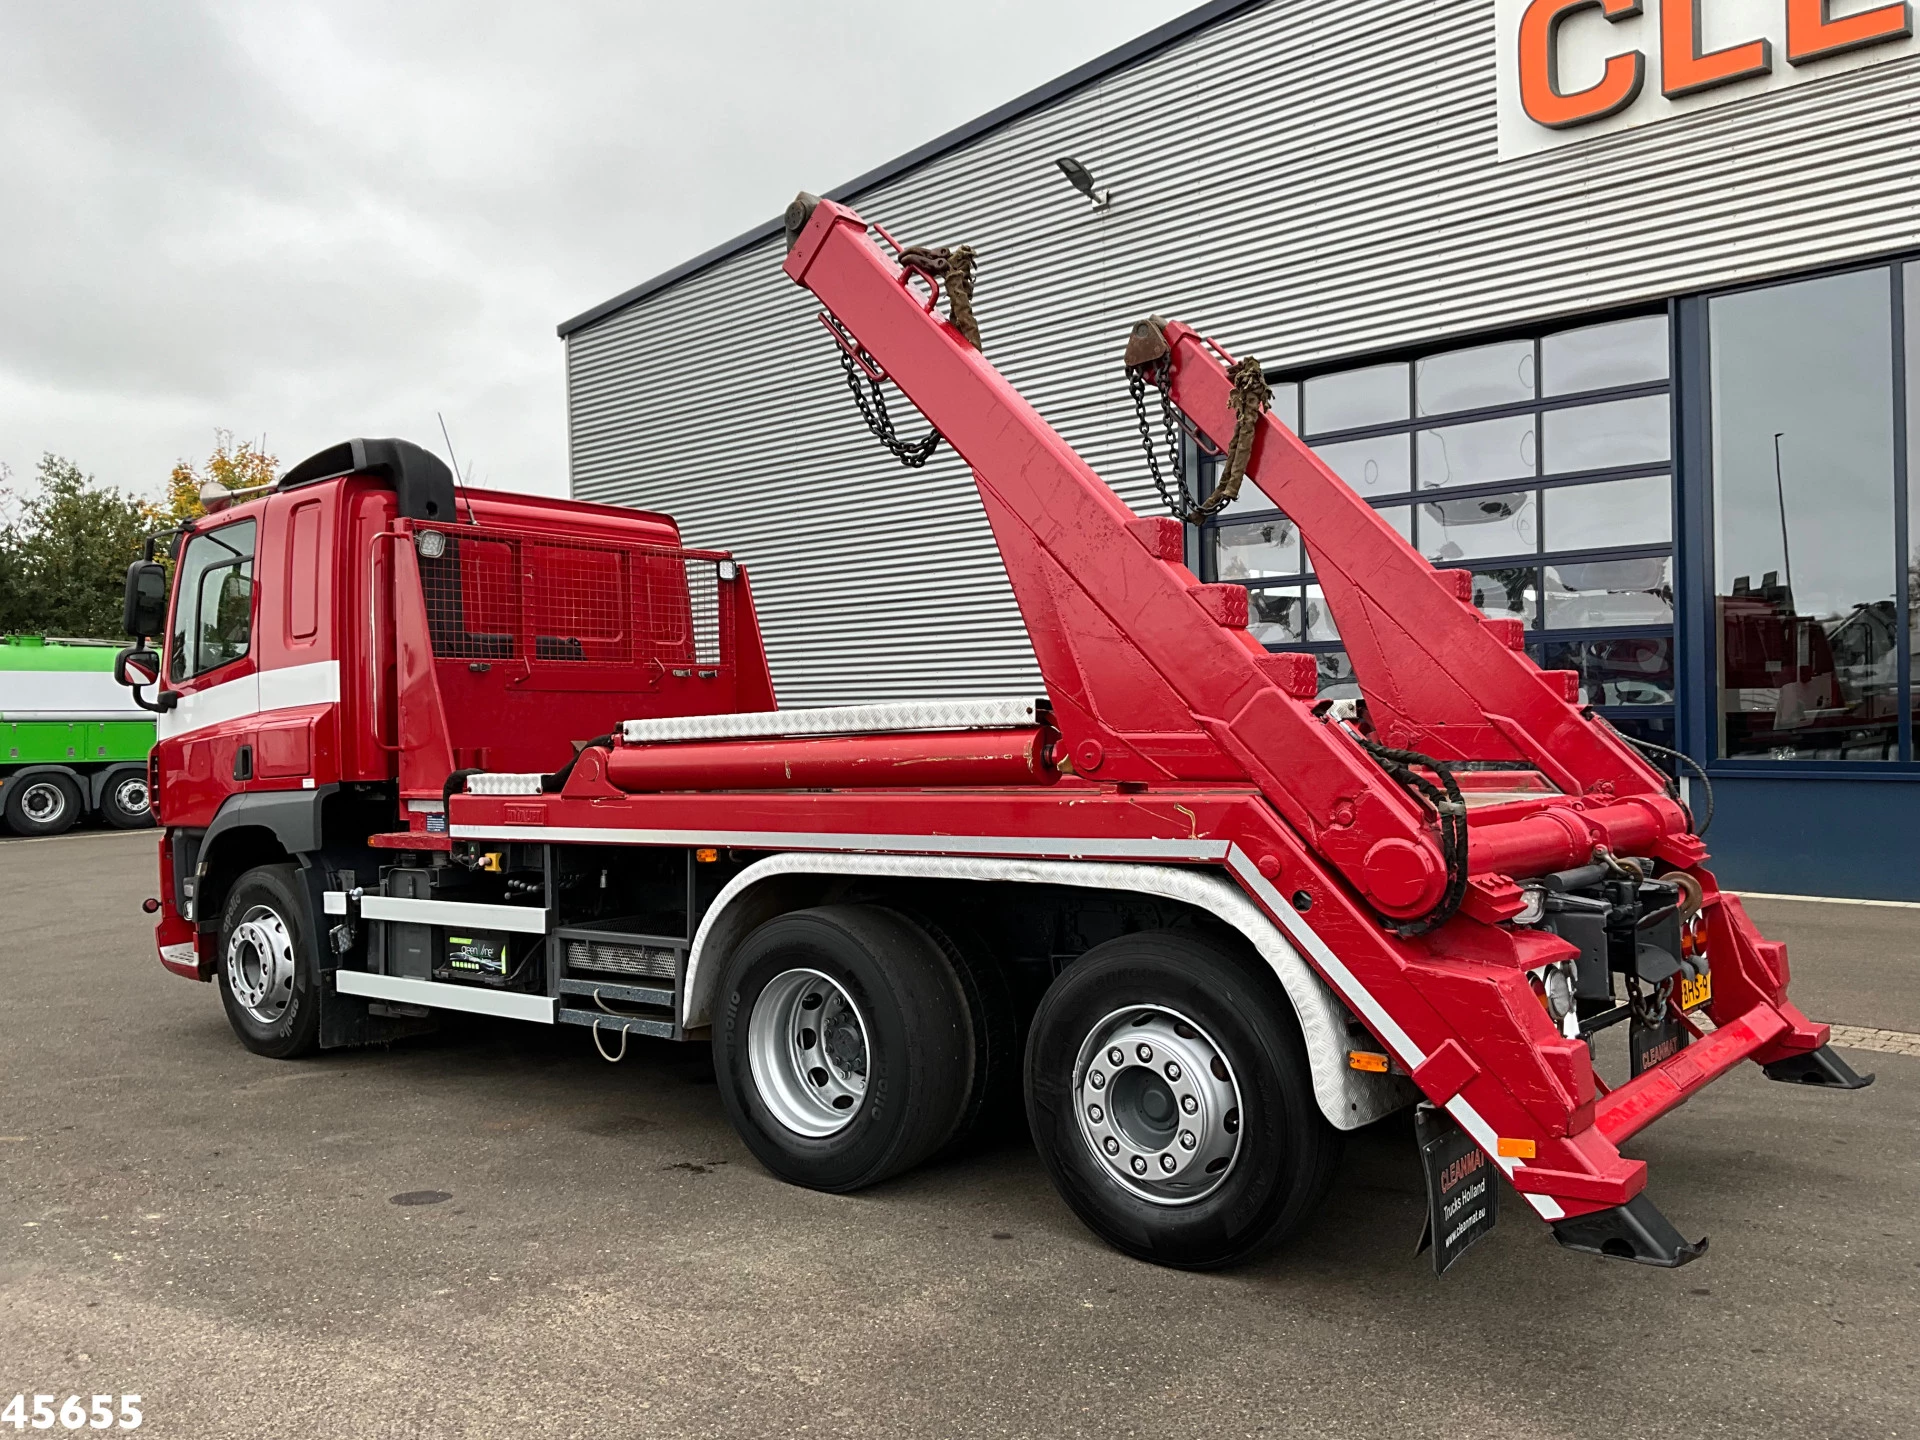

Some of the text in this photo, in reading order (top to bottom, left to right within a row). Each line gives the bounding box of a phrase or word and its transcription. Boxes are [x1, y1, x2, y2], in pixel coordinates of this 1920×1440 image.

[223, 893, 241, 933] apollo
[280, 998, 299, 1038] apollo
[1642, 1036, 1679, 1070] CLEANMAT
[1443, 1177, 1486, 1222] Trucks Holland
[1445, 1207, 1486, 1248] www.cleanmat.eu
